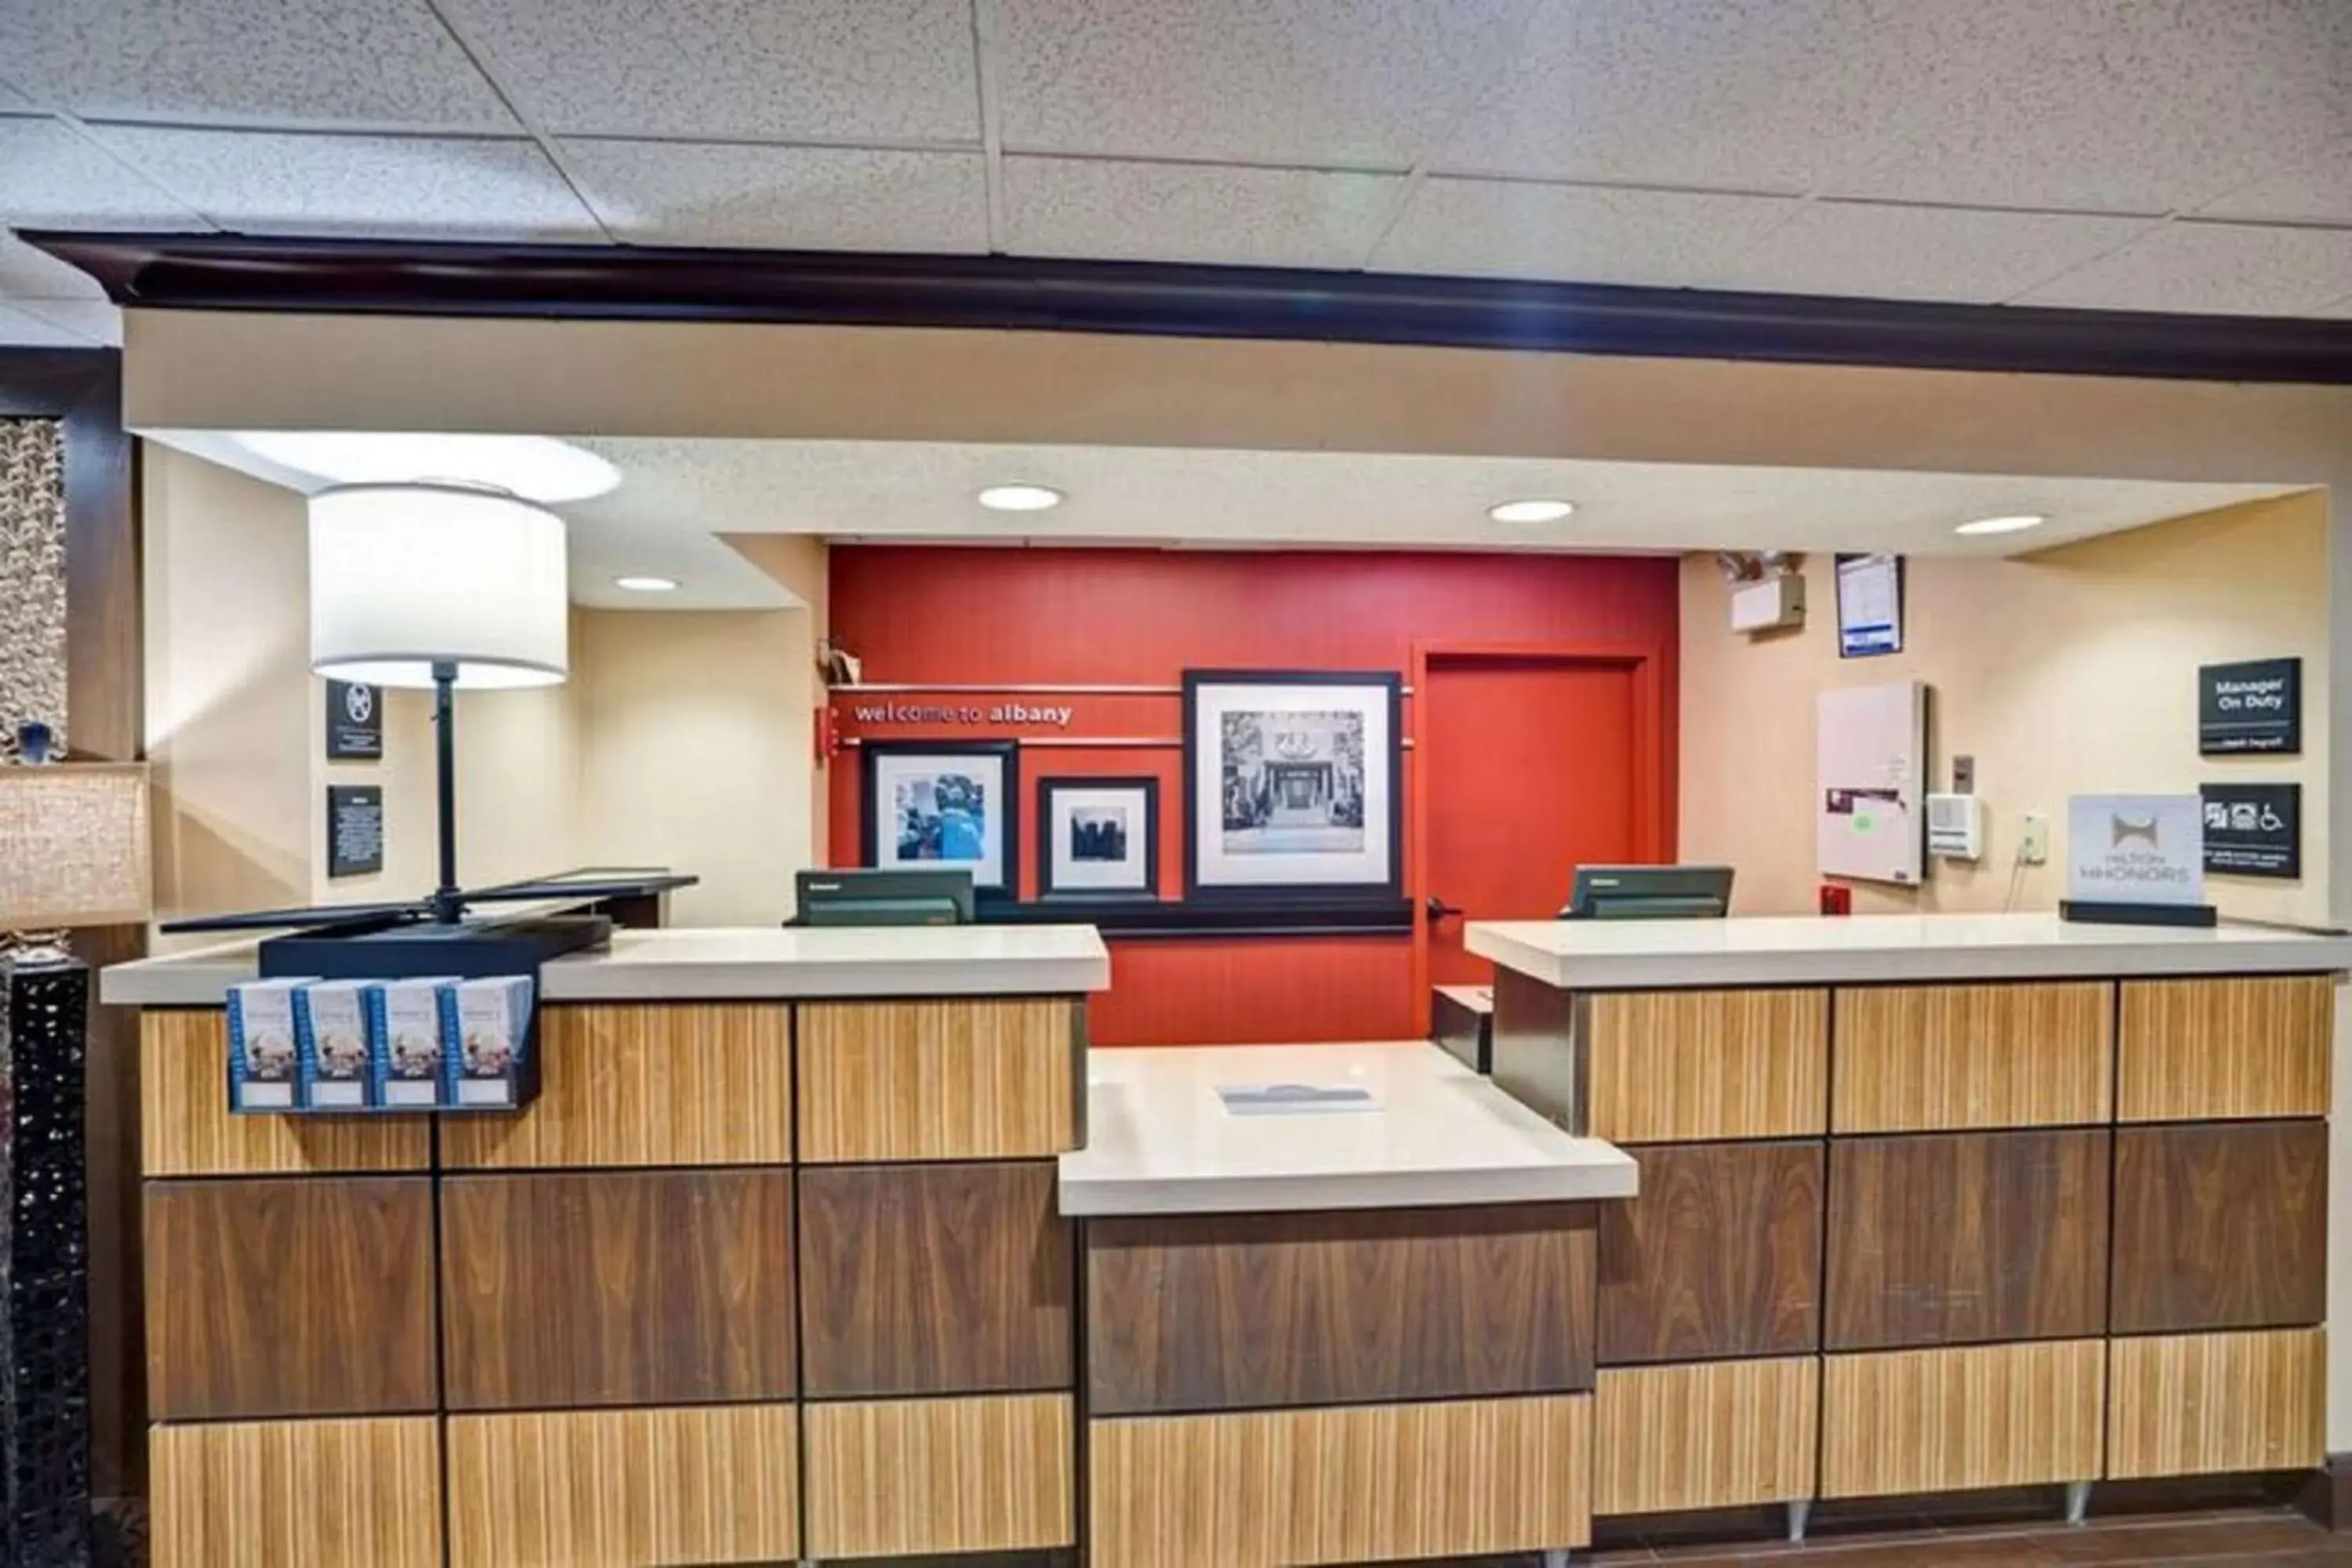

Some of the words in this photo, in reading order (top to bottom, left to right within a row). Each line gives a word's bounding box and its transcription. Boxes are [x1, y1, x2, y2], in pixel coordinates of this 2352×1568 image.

[2215, 678, 2285, 695] Manager
[2218, 695, 2241, 710] On
[2245, 695, 2283, 710] Duty
[854, 700, 954, 723] welcome
[959, 706, 982, 723] to
[989, 703, 1072, 726] albany
